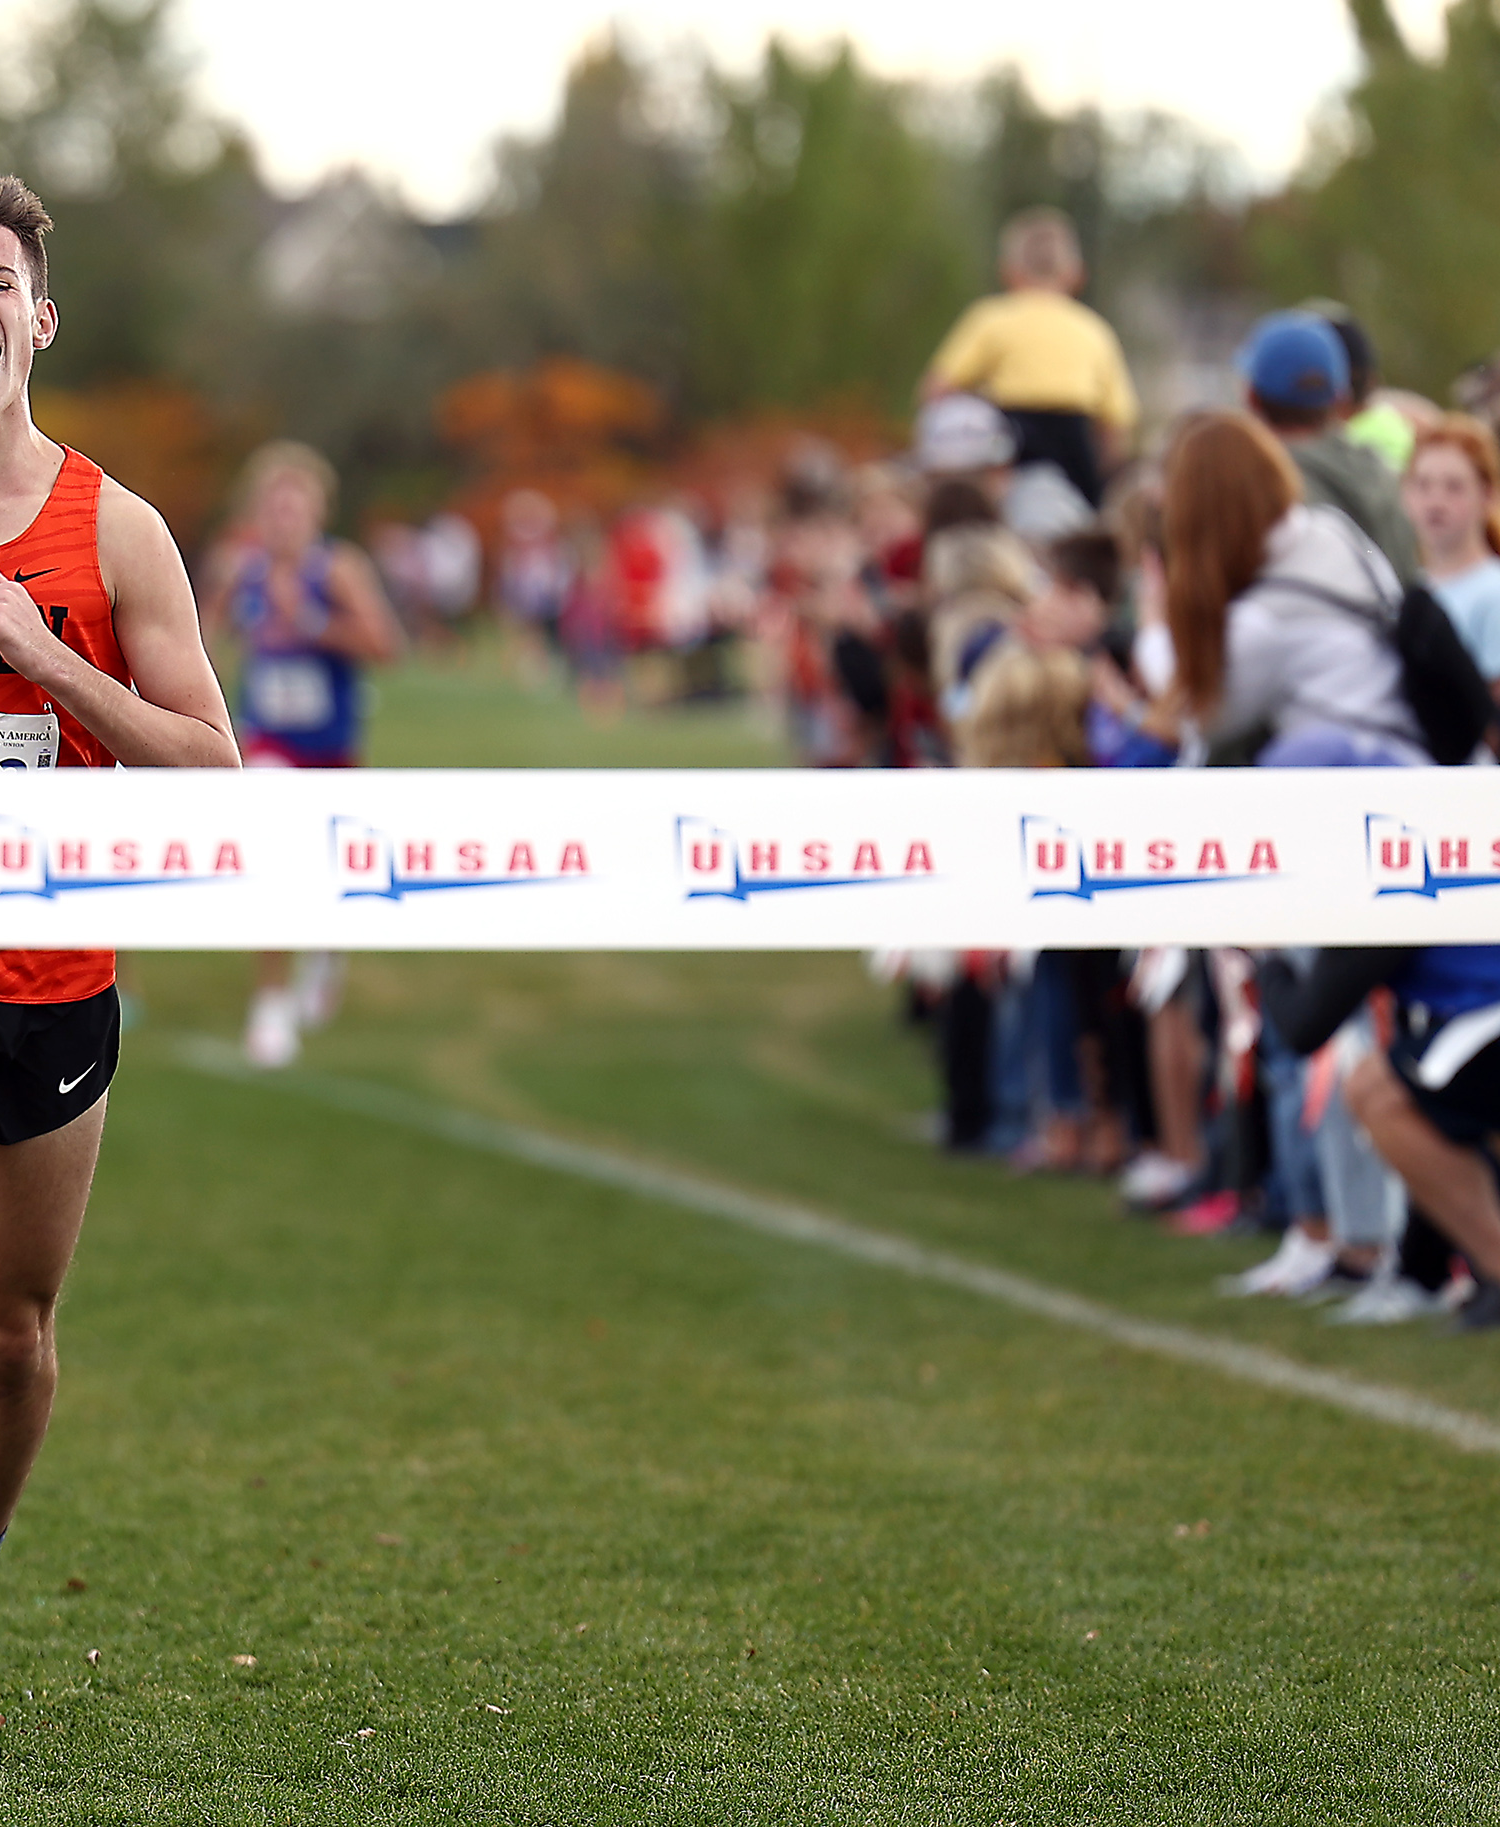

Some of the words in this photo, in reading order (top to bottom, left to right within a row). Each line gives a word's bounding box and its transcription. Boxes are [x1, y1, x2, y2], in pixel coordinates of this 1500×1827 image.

[4, 728, 51, 742] AMERICA
[344, 840, 590, 875] UHSAA
[690, 840, 935, 875] UHSAA
[1035, 838, 1280, 874] UHSAA
